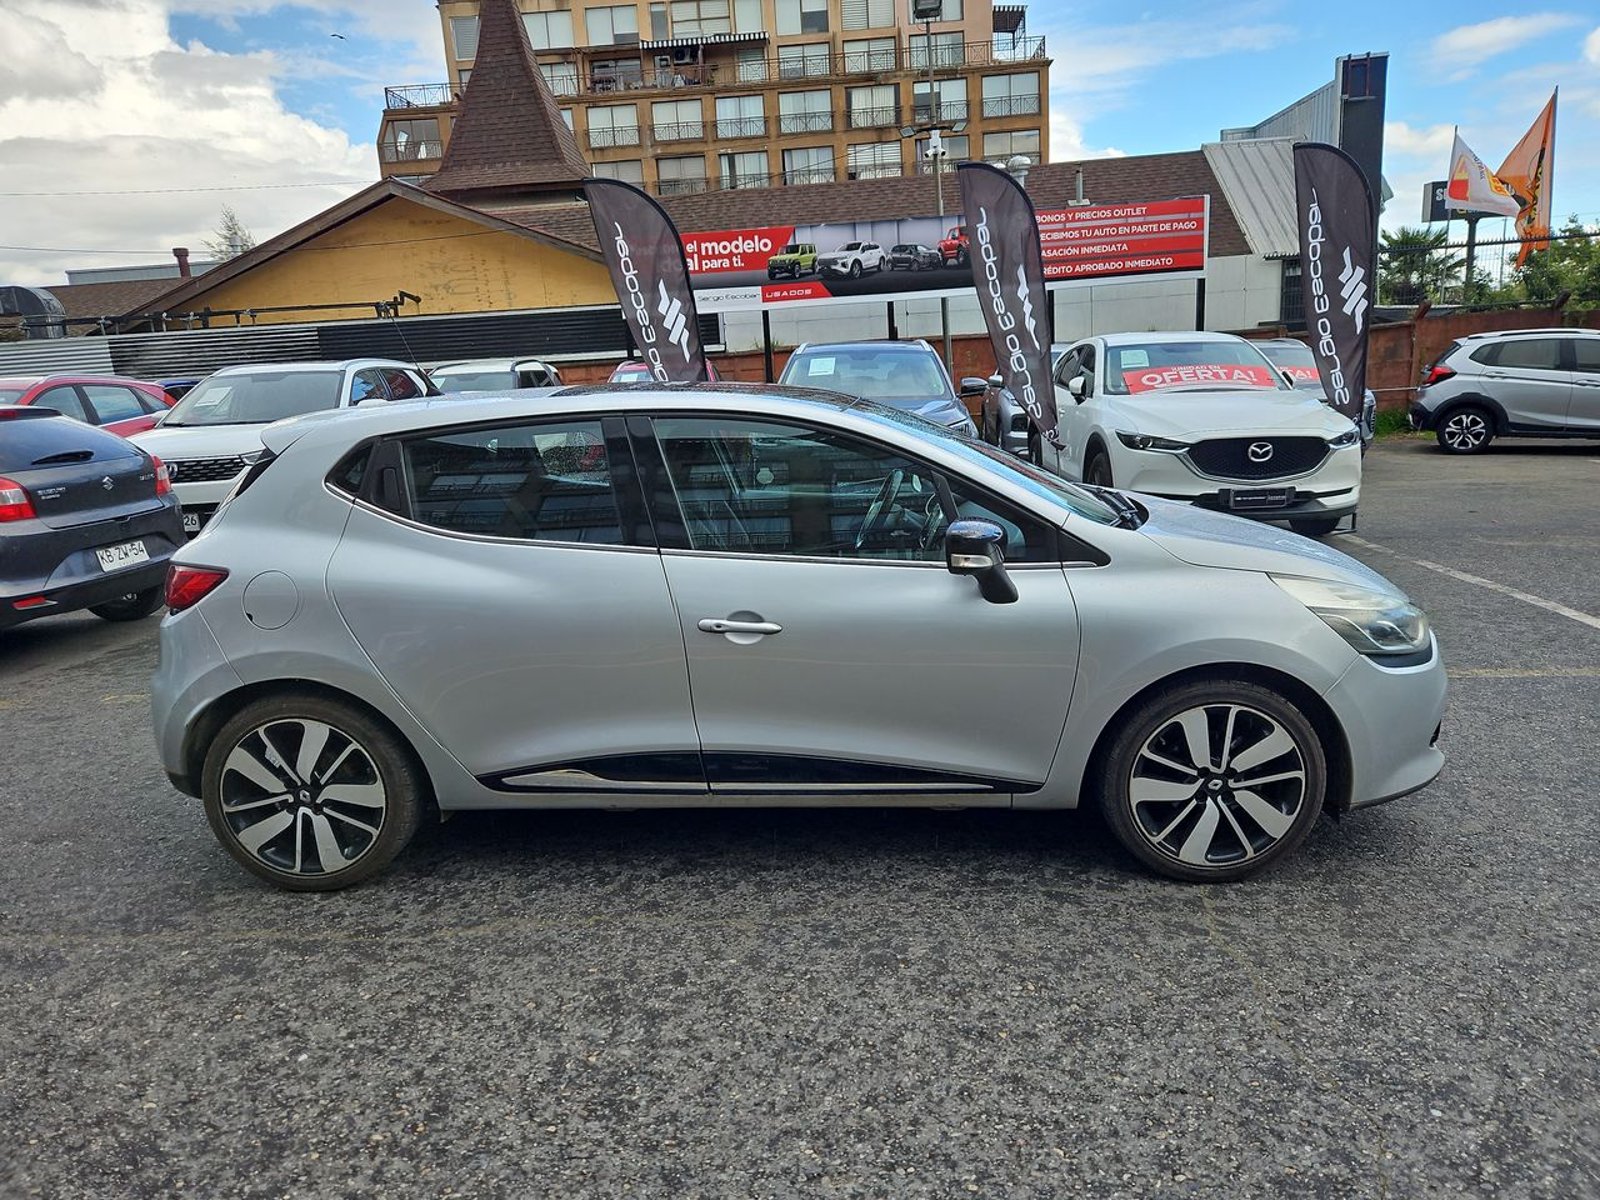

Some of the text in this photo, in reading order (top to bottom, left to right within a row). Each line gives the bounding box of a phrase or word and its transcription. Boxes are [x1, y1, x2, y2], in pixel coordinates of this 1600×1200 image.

[1035, 206, 1147, 223] BONOS Y PRECIOS OUTLET
[1040, 220, 1197, 241] ECIBIMOS TU AUTO EN PARTE DE PAGO
[686, 235, 772, 256] el modelo
[1041, 243, 1128, 257] ASACIÓN INMEDIATA
[702, 258, 730, 271] para
[732, 255, 745, 267] ti.
[1043, 257, 1173, 275] RÉDITO APROBADO INMEDIATO
[766, 288, 812, 298] USADOS
[1141, 367, 1257, 387] OFERTA!
[184, 515, 197, 526] 26
